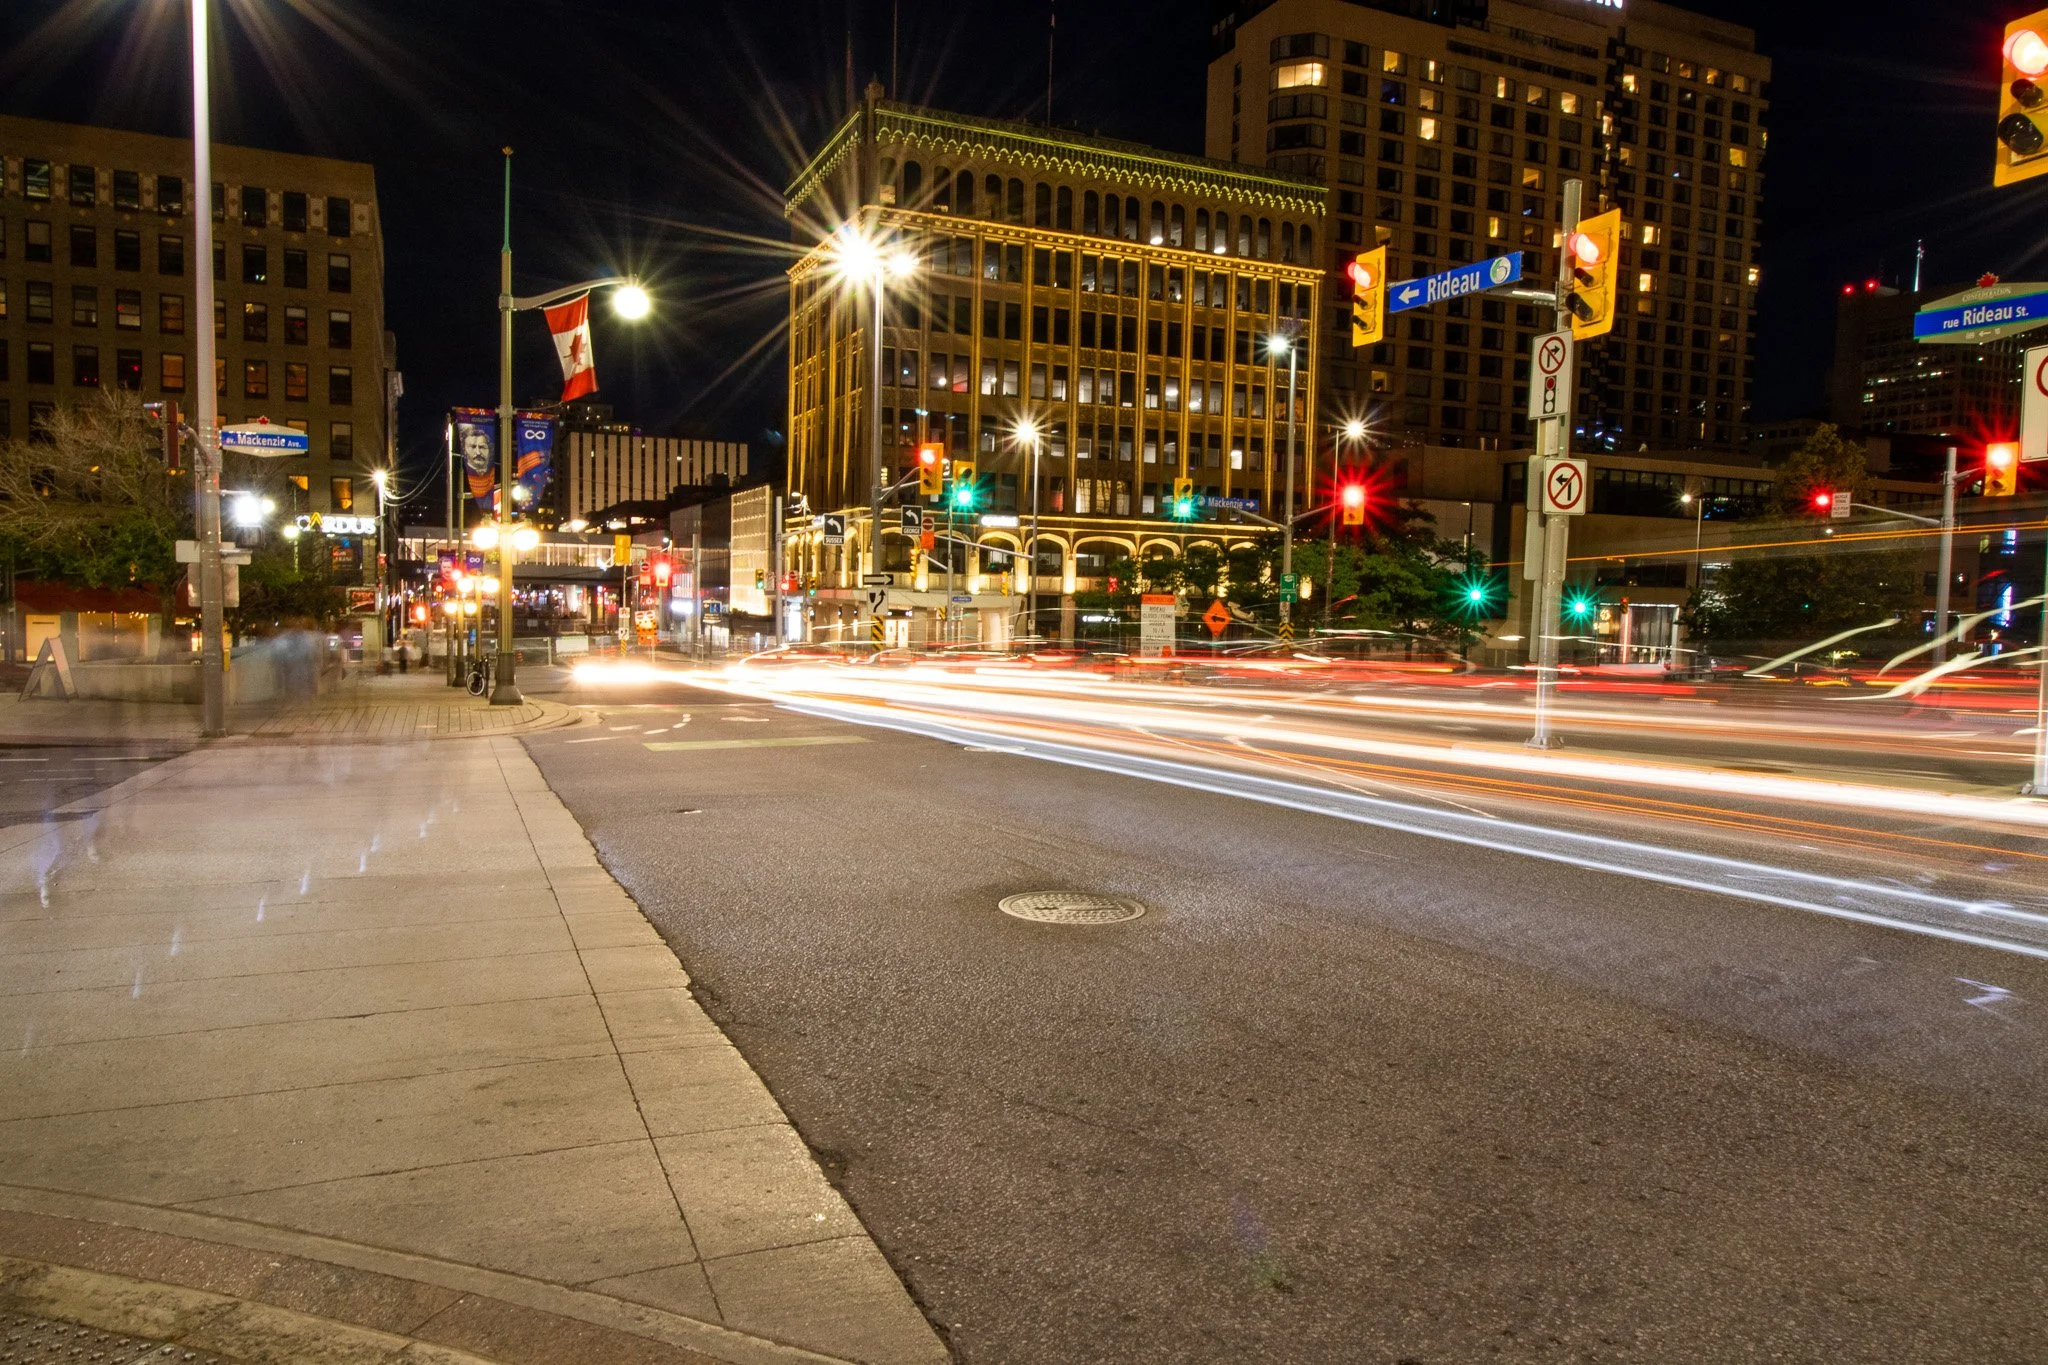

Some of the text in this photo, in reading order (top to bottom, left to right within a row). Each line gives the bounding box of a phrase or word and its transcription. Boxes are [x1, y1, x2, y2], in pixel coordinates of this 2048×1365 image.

[1427, 271, 1480, 302] Rideau
[1943, 306, 2029, 329] rue Rideau St.
[237, 434, 286, 447] Mackenzie
[287, 440, 302, 448] Ave.
[1208, 497, 1244, 509] Mackenzie
